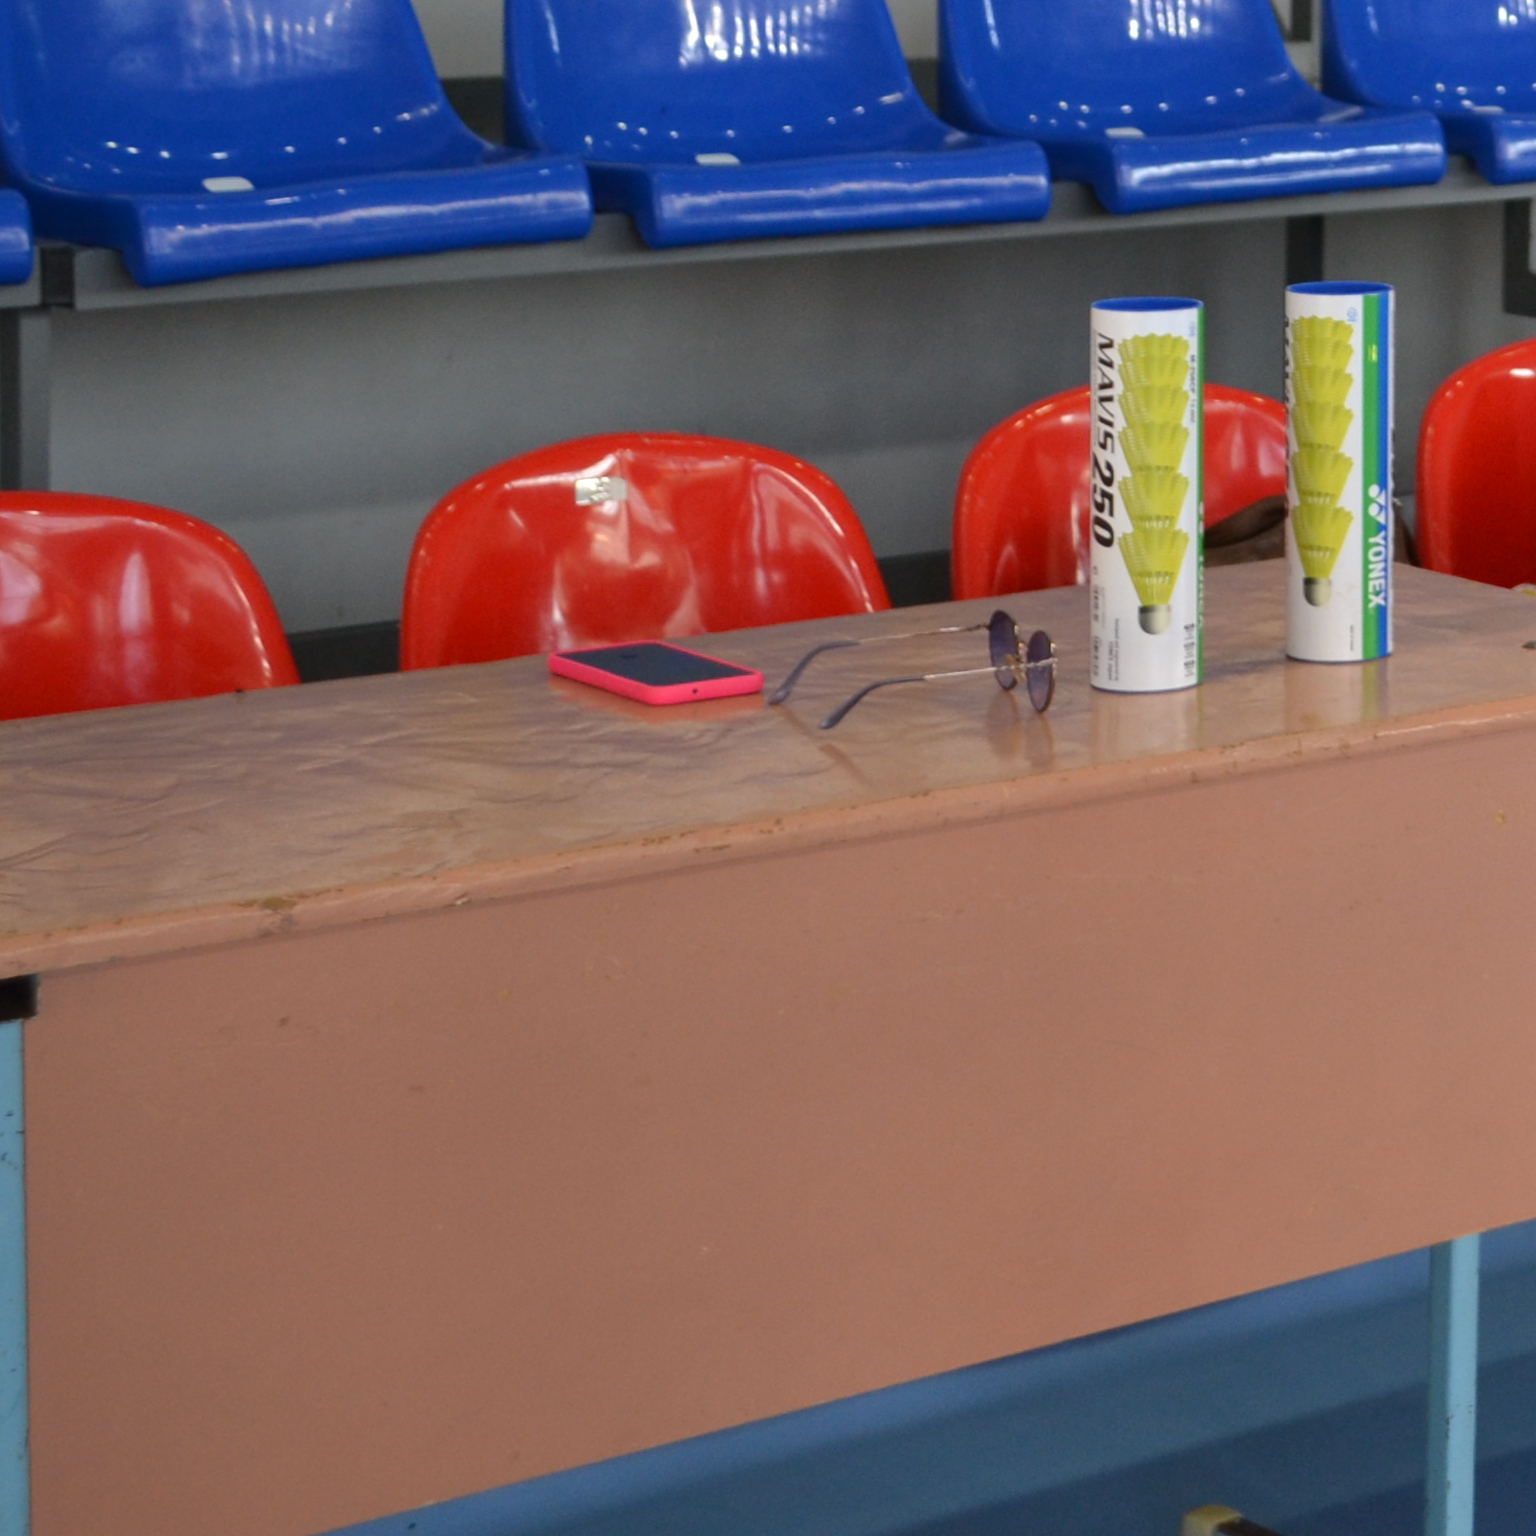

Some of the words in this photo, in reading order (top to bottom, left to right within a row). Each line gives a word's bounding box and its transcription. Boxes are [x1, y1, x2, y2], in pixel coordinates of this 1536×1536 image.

[1097, 332, 1115, 455] MAVIS
[1092, 454, 1114, 548] 250
[1368, 530, 1386, 608] YONEX
